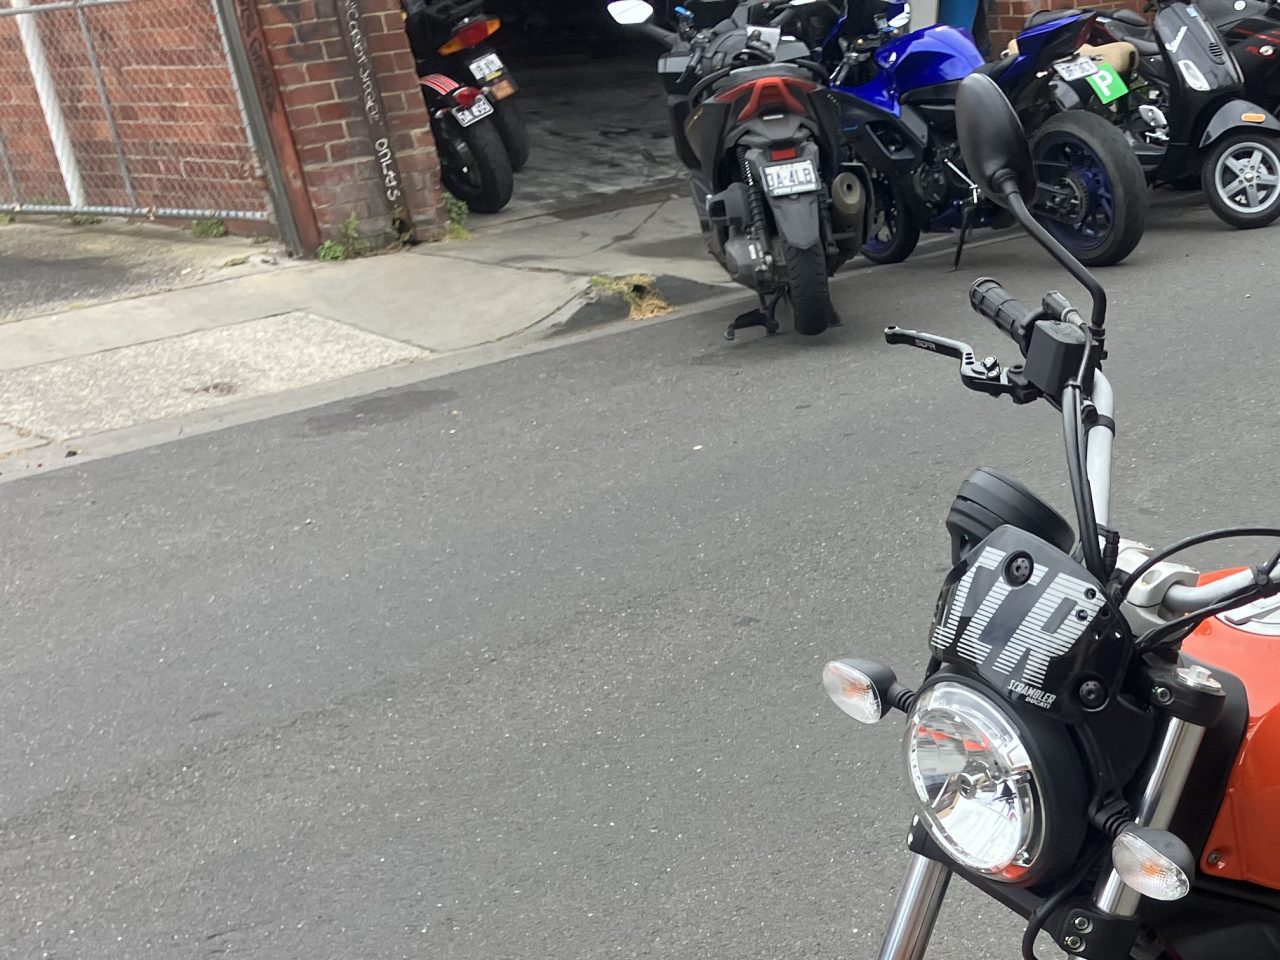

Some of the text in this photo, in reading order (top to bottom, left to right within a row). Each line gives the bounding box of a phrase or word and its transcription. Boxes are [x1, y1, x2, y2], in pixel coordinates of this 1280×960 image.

[1092, 69, 1113, 97] P
[1007, 679, 1057, 704] SCRAMBLER
[1025, 696, 1051, 709] DUCATI
